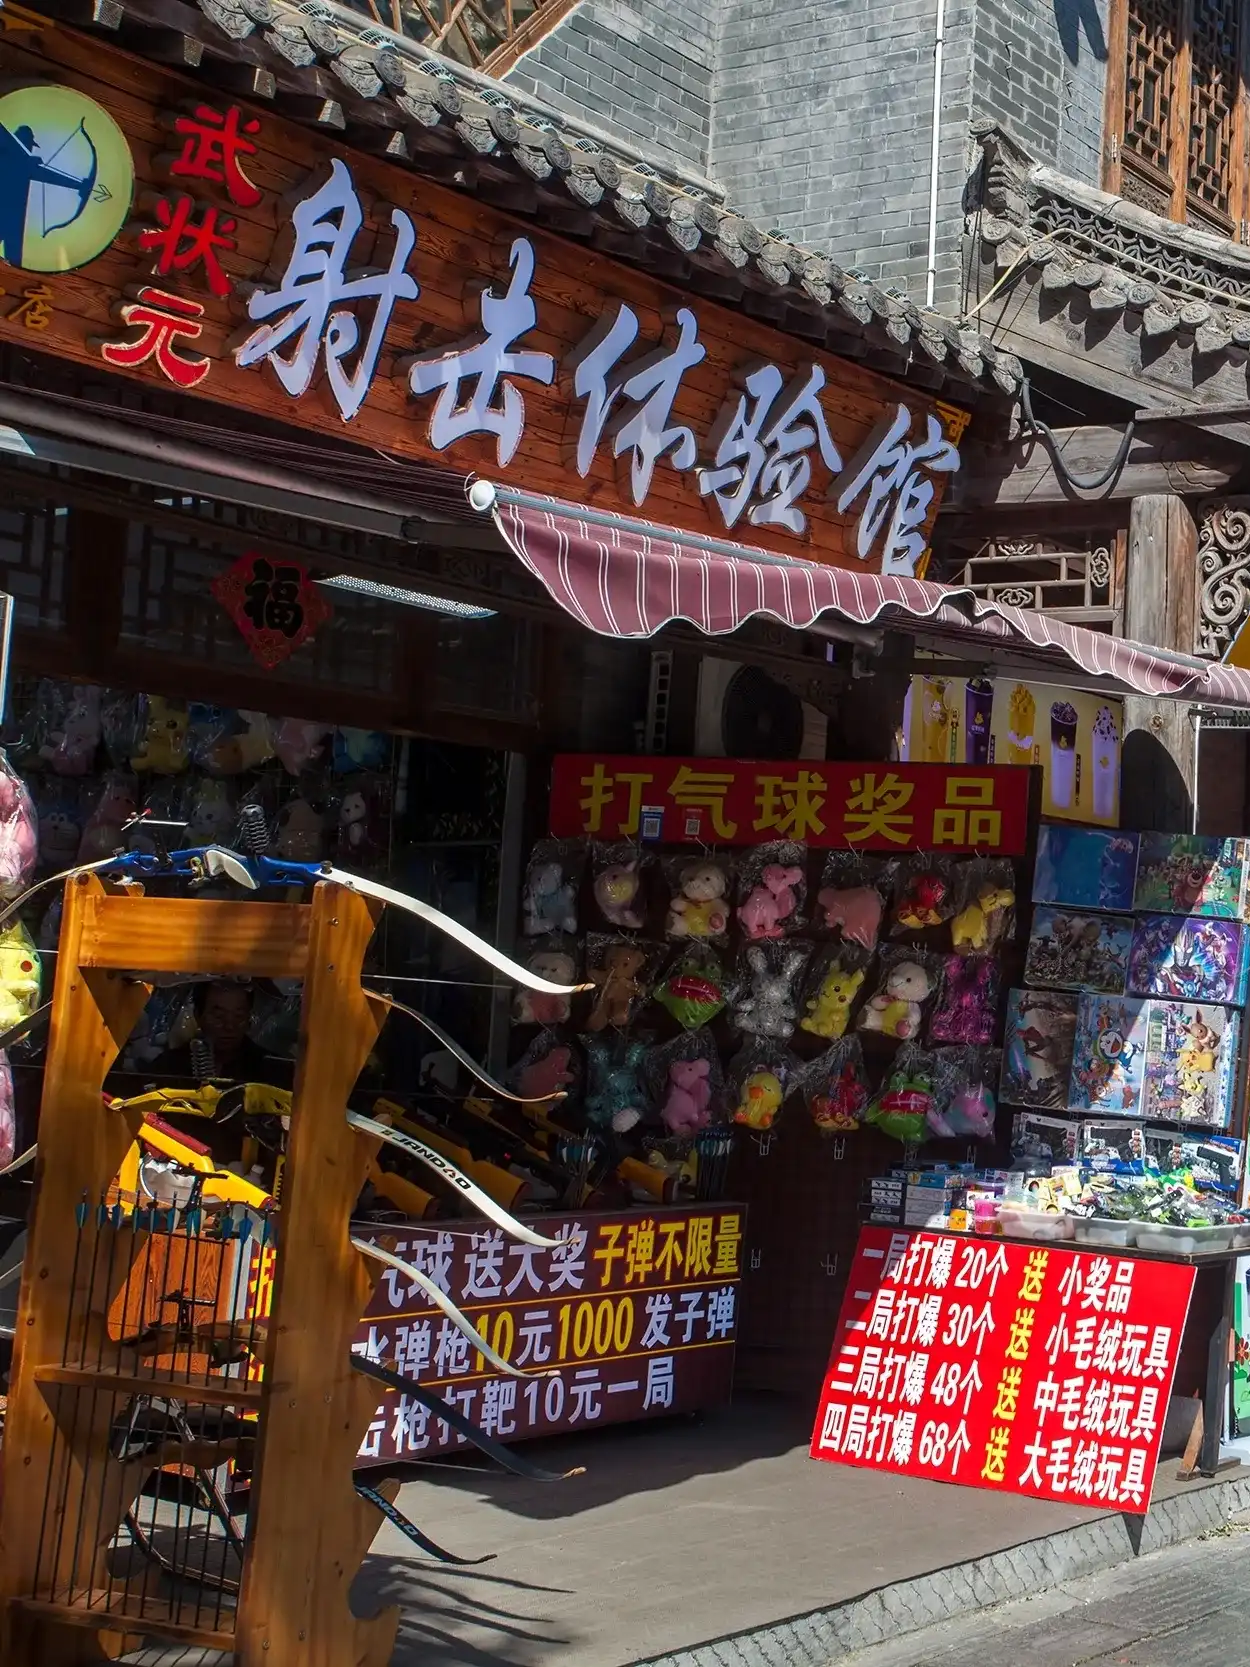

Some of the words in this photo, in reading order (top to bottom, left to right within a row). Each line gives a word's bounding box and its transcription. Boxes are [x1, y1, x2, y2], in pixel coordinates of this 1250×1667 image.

[102, 105, 262, 388] 武状元
[0, 284, 55, 330] 店
[236, 157, 960, 577] 射击体验馆
[243, 558, 304, 639] 福
[580, 764, 1002, 847] 打气球奖品
[594, 1214, 742, 1287] 子弹不限量
[1018, 1249, 1049, 1302] 送
[1058, 1254, 1135, 1314] 小奖品
[1005, 1307, 1036, 1361] 送
[1045, 1312, 1172, 1382] 小毛绒玩具
[992, 1366, 1023, 1421] 送
[1033, 1371, 1159, 1443] 中毛绒玩具
[981, 1426, 1011, 1482] 送
[1018, 1431, 1147, 1506] 大毛绒玩具
